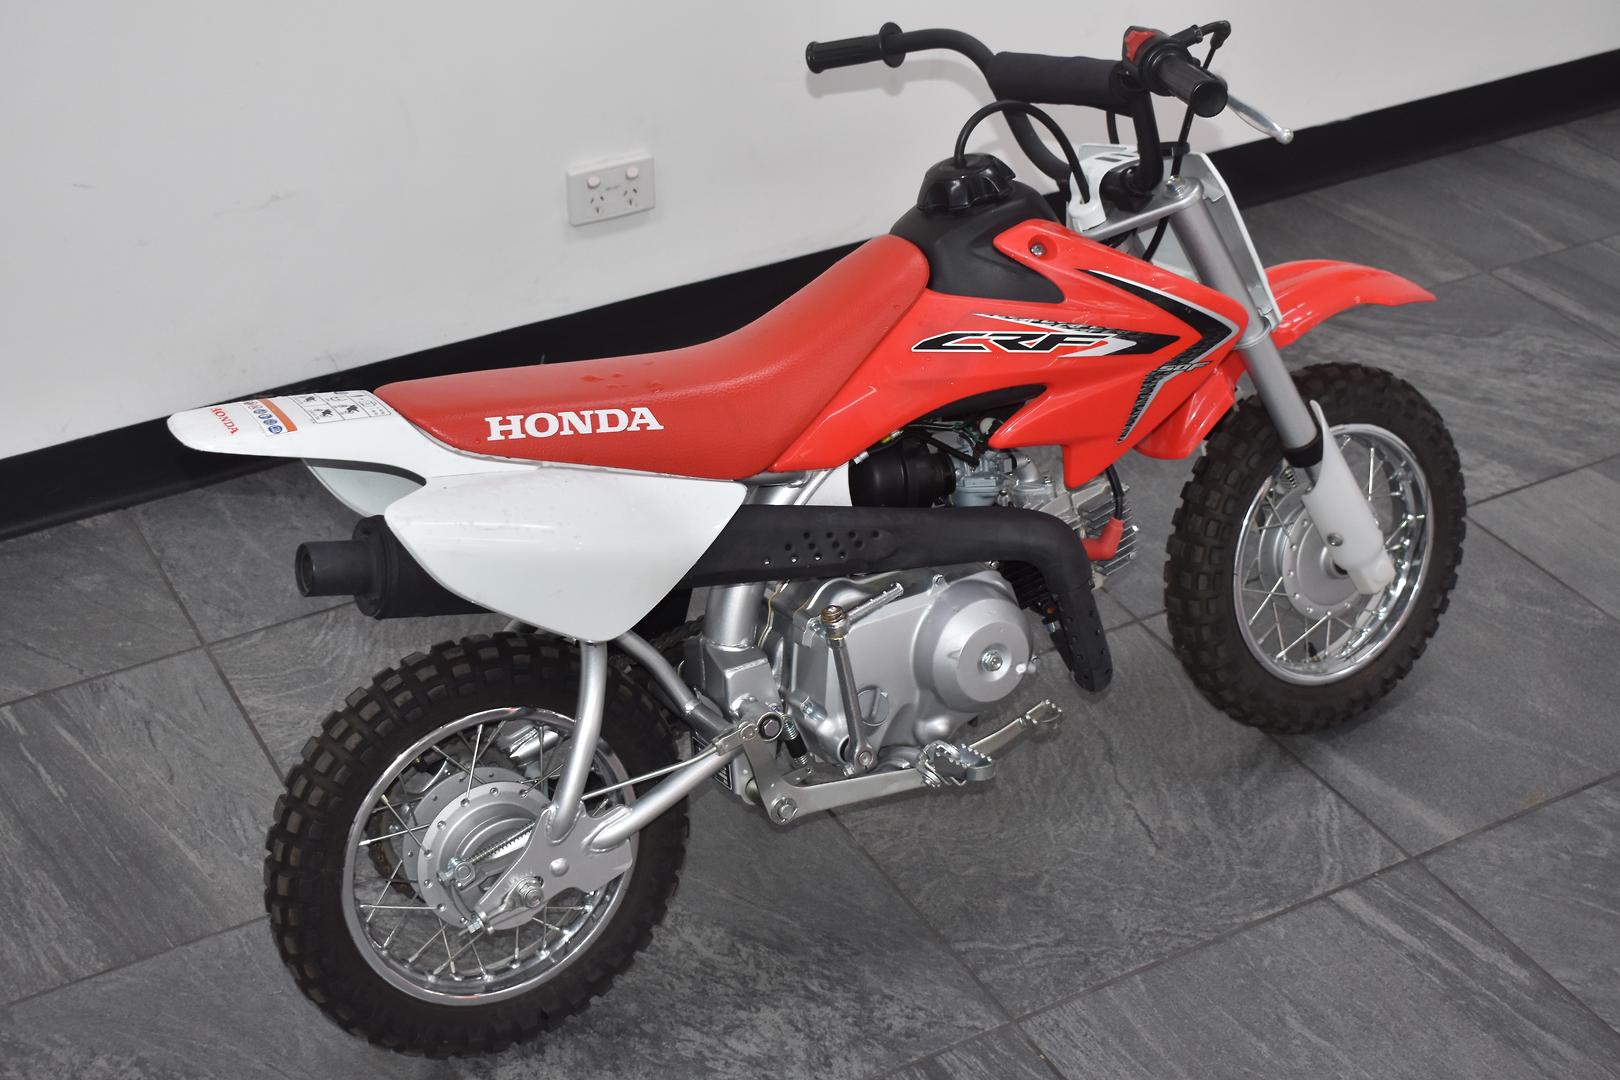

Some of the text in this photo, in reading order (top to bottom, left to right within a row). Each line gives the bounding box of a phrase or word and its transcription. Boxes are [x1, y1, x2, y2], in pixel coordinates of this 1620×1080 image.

[911, 331, 1116, 353] CRF
[210, 406, 240, 434] HONDA
[485, 406, 664, 441] HONDA
